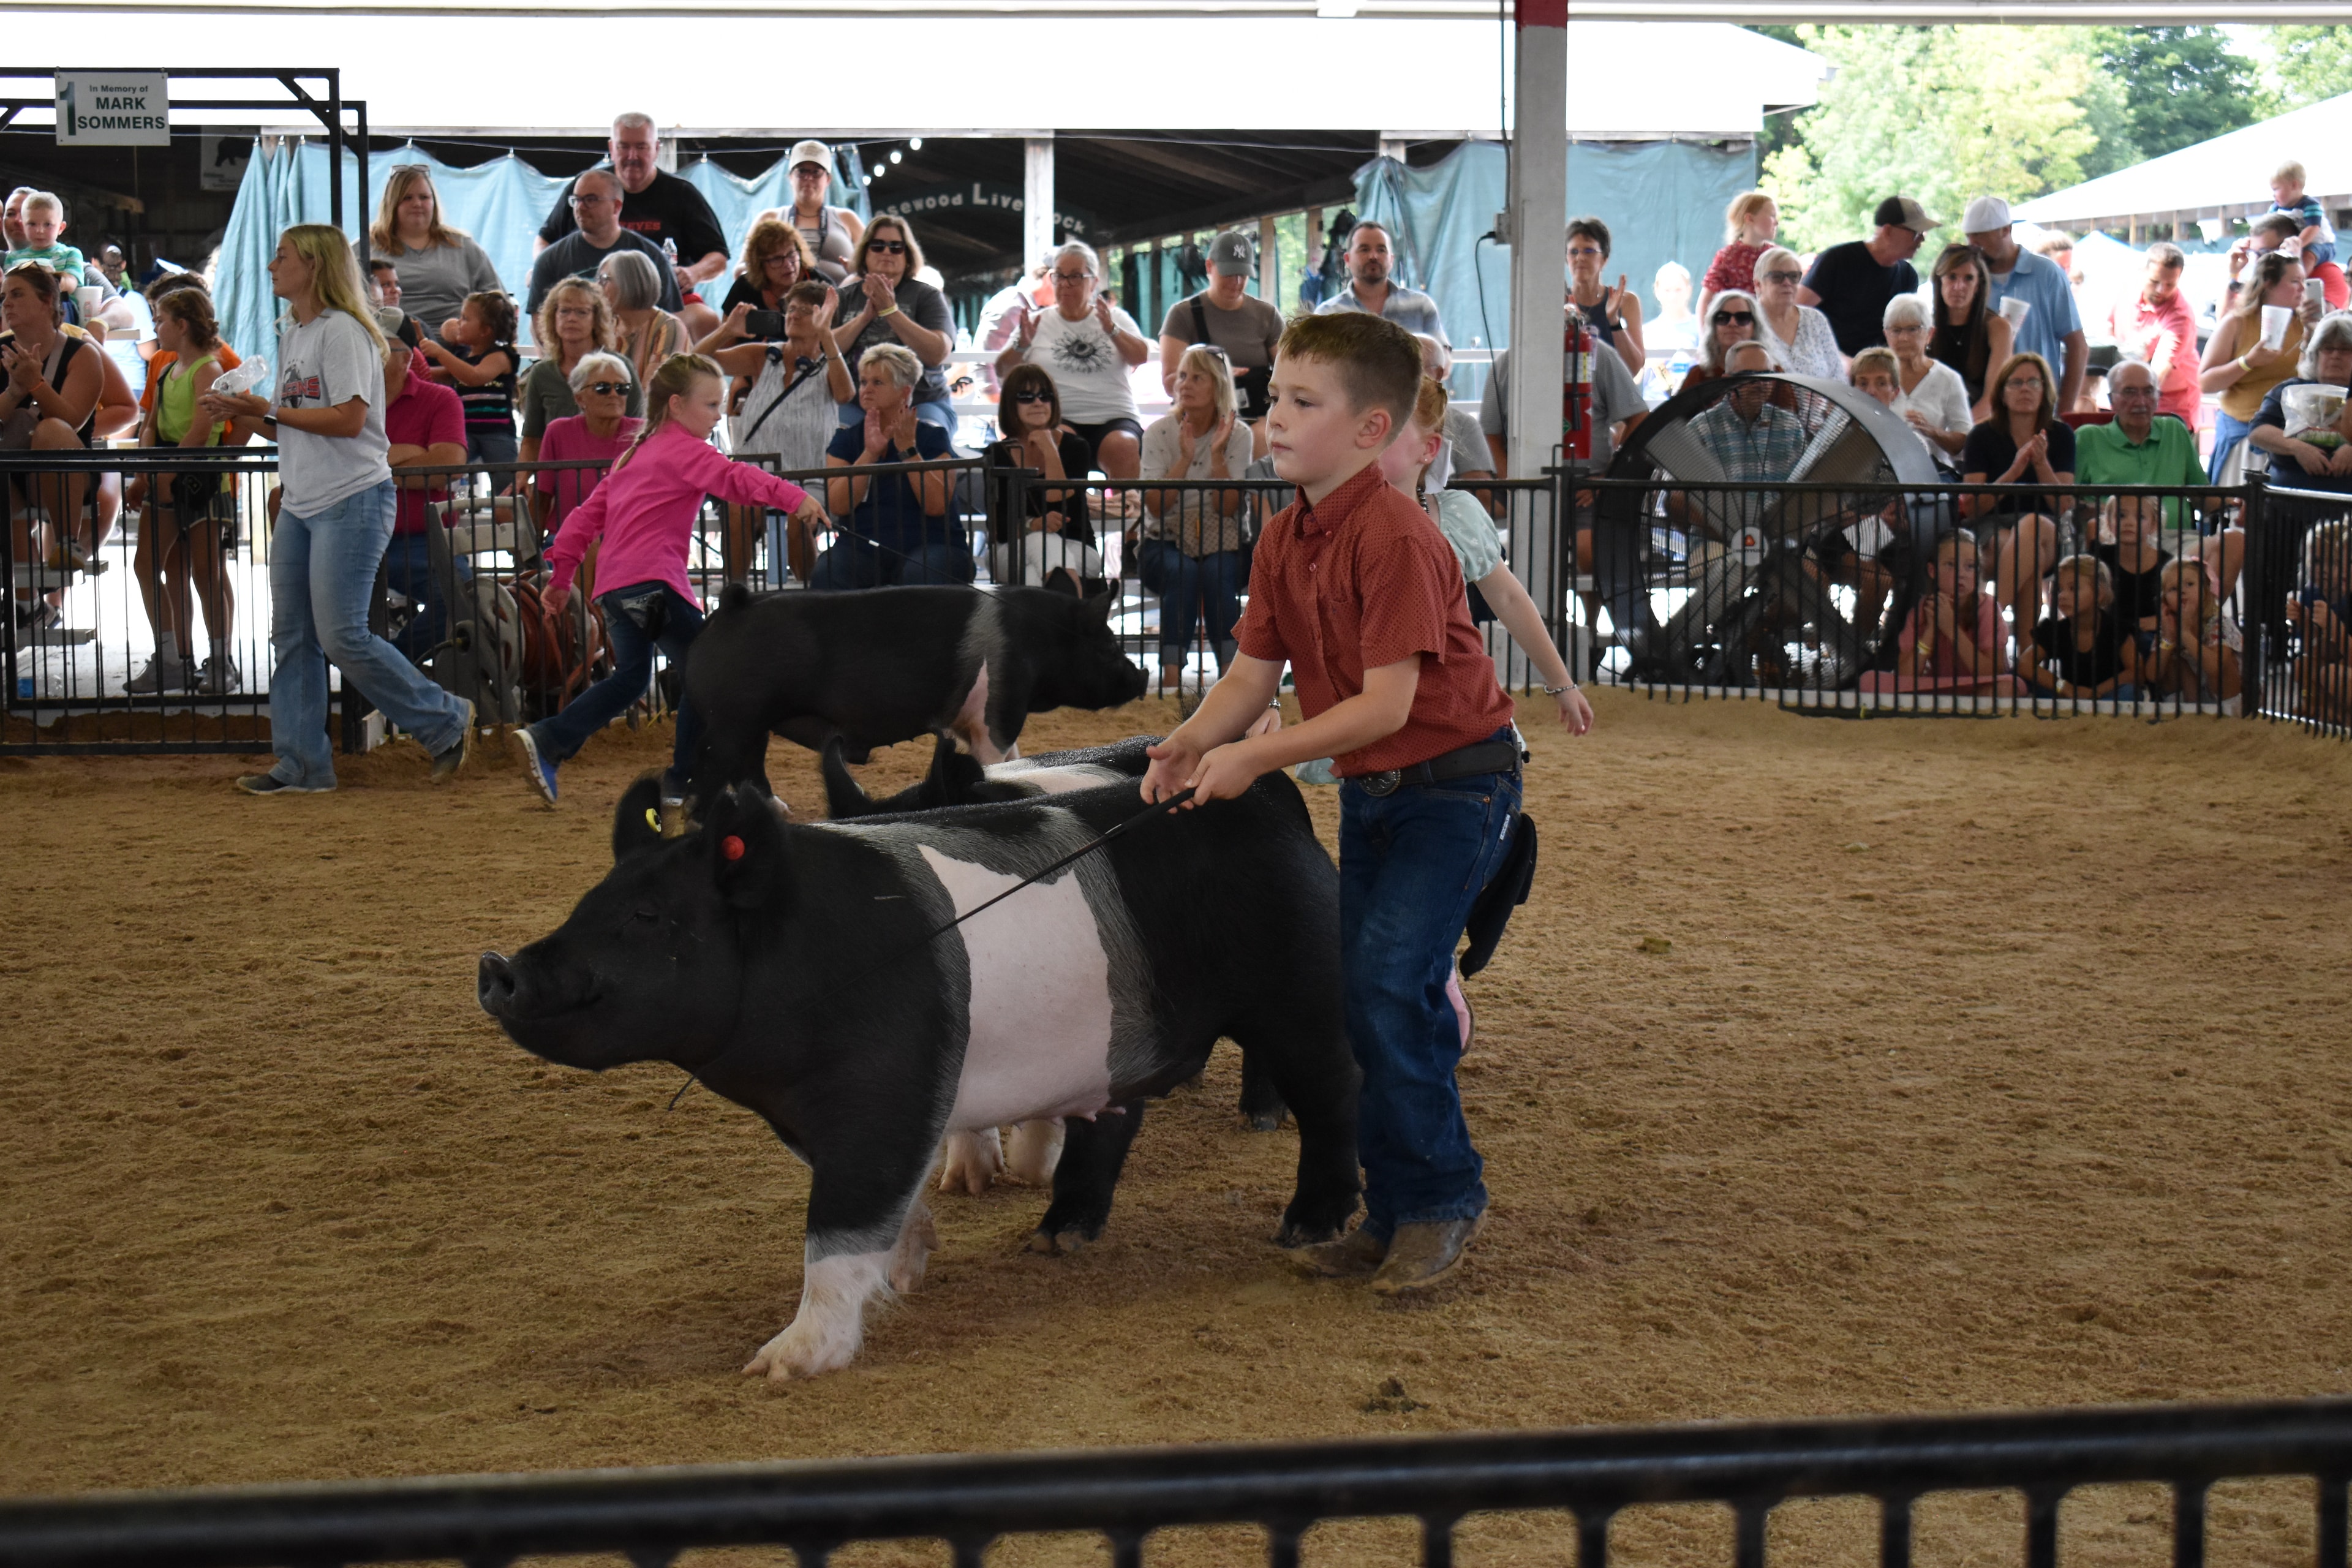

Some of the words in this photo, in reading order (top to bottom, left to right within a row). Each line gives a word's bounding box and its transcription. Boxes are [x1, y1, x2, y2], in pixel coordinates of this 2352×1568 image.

[101, 85, 136, 94] Memory
[59, 81, 76, 136] 1
[96, 97, 146, 110] MARK
[77, 116, 165, 129] SOMMERS
